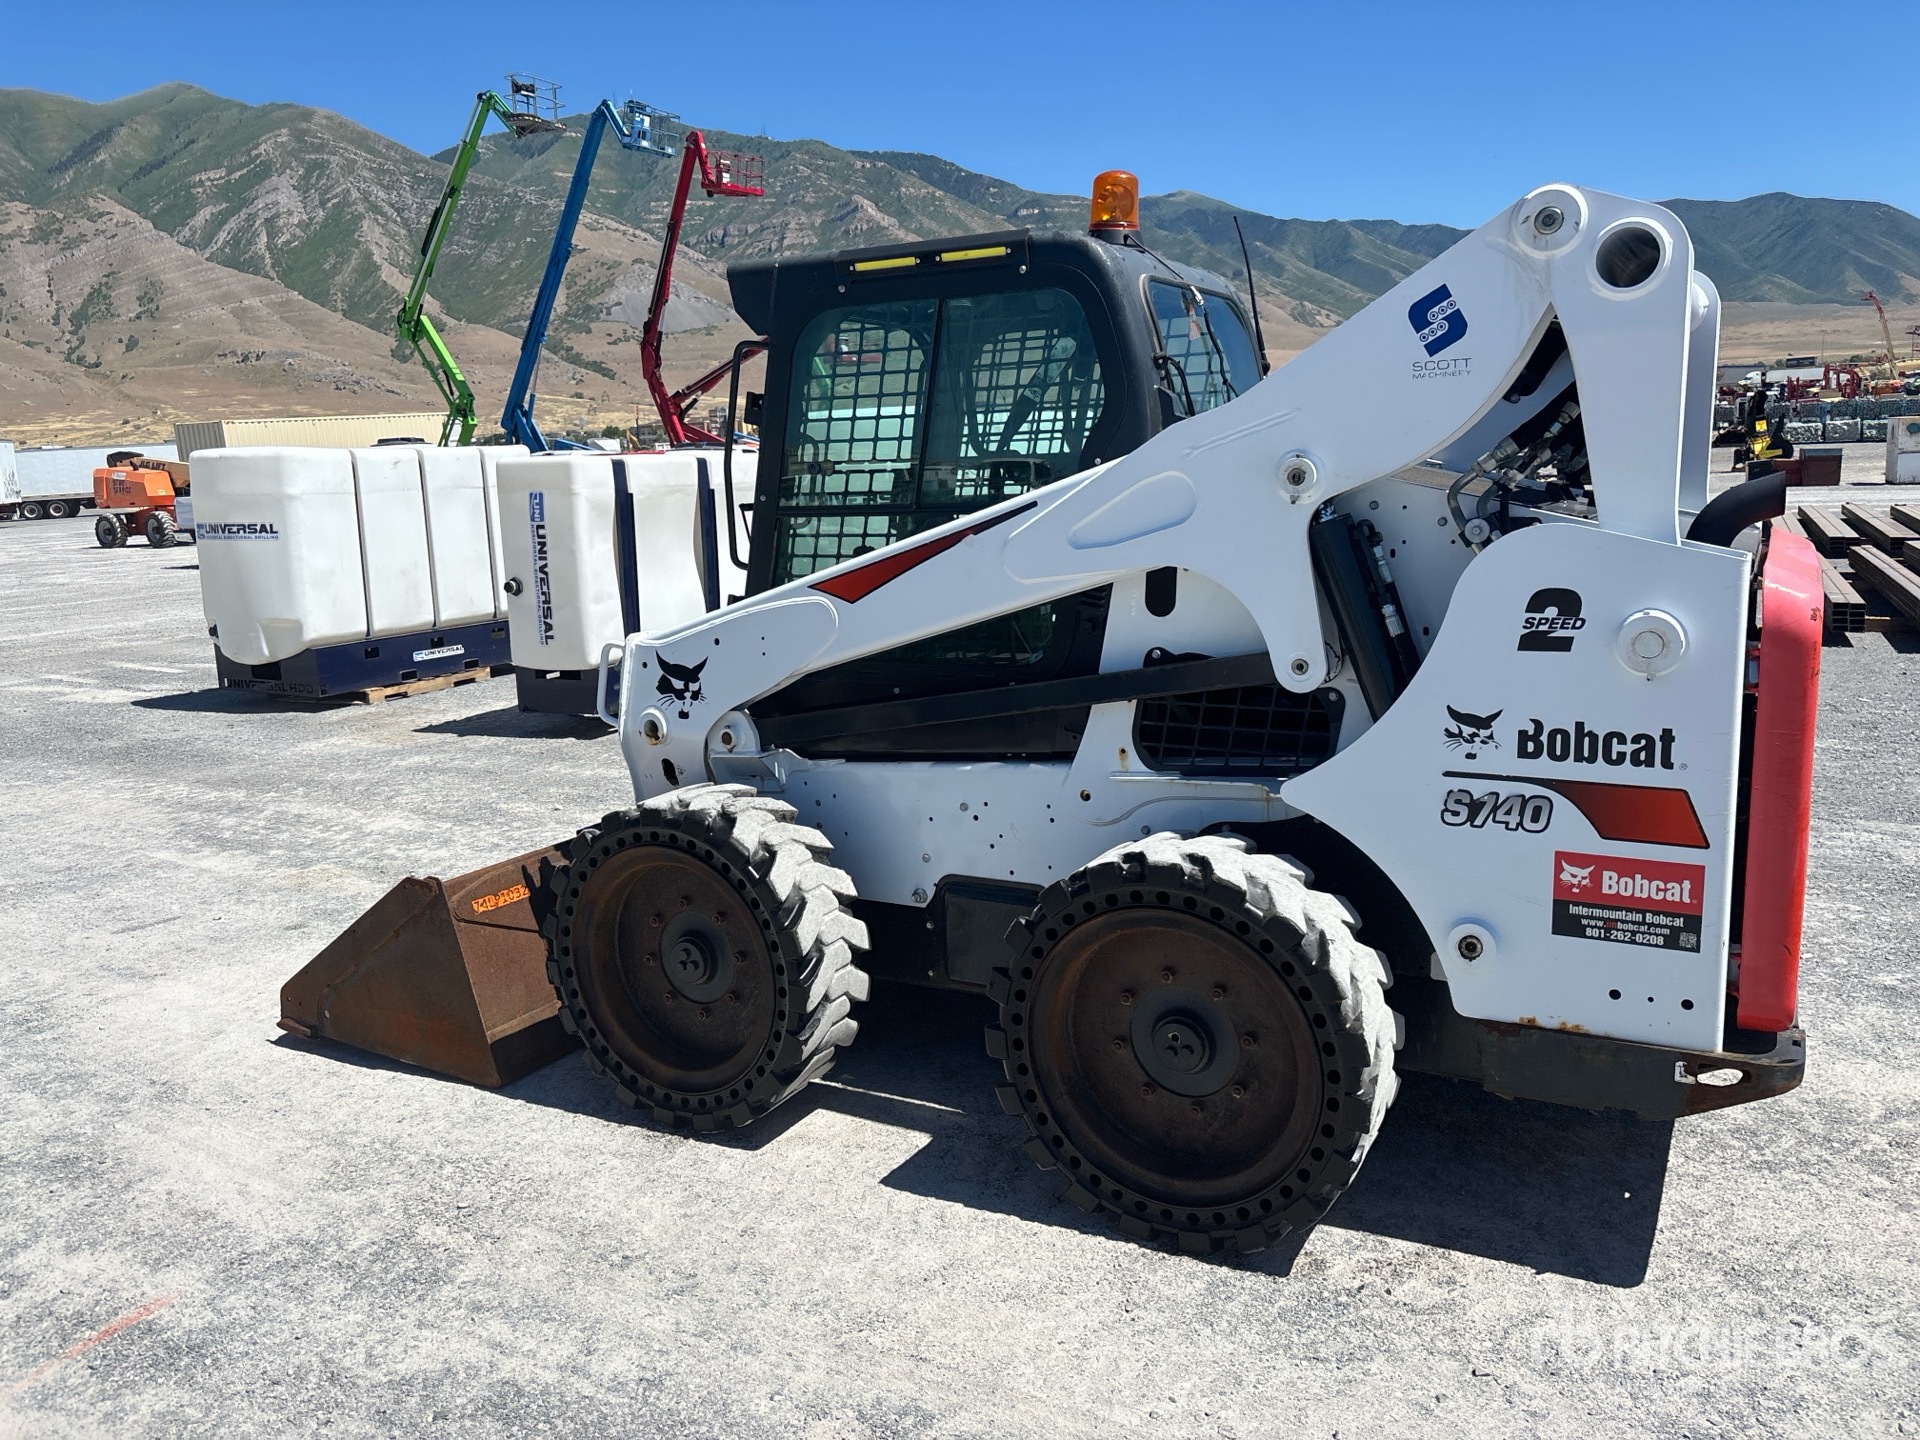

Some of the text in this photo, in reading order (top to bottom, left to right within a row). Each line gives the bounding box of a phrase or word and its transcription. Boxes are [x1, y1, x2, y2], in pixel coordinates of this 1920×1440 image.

[1412, 358, 1472, 372] SCOTT
[205, 523, 279, 534] UNIVERSAL
[536, 525, 555, 645] UNIVERSAL
[1517, 587, 1583, 653] 2
[1522, 616, 1587, 631] SPEED
[424, 644, 463, 656] UNIVERSAL
[1516, 718, 1676, 770] Bobcat
[1440, 788, 1554, 834] S740
[1601, 870, 1692, 904] Bobcat
[1569, 904, 1685, 928] Intermountain Bobcat
[1585, 927, 1665, 946] 801-262-0208
